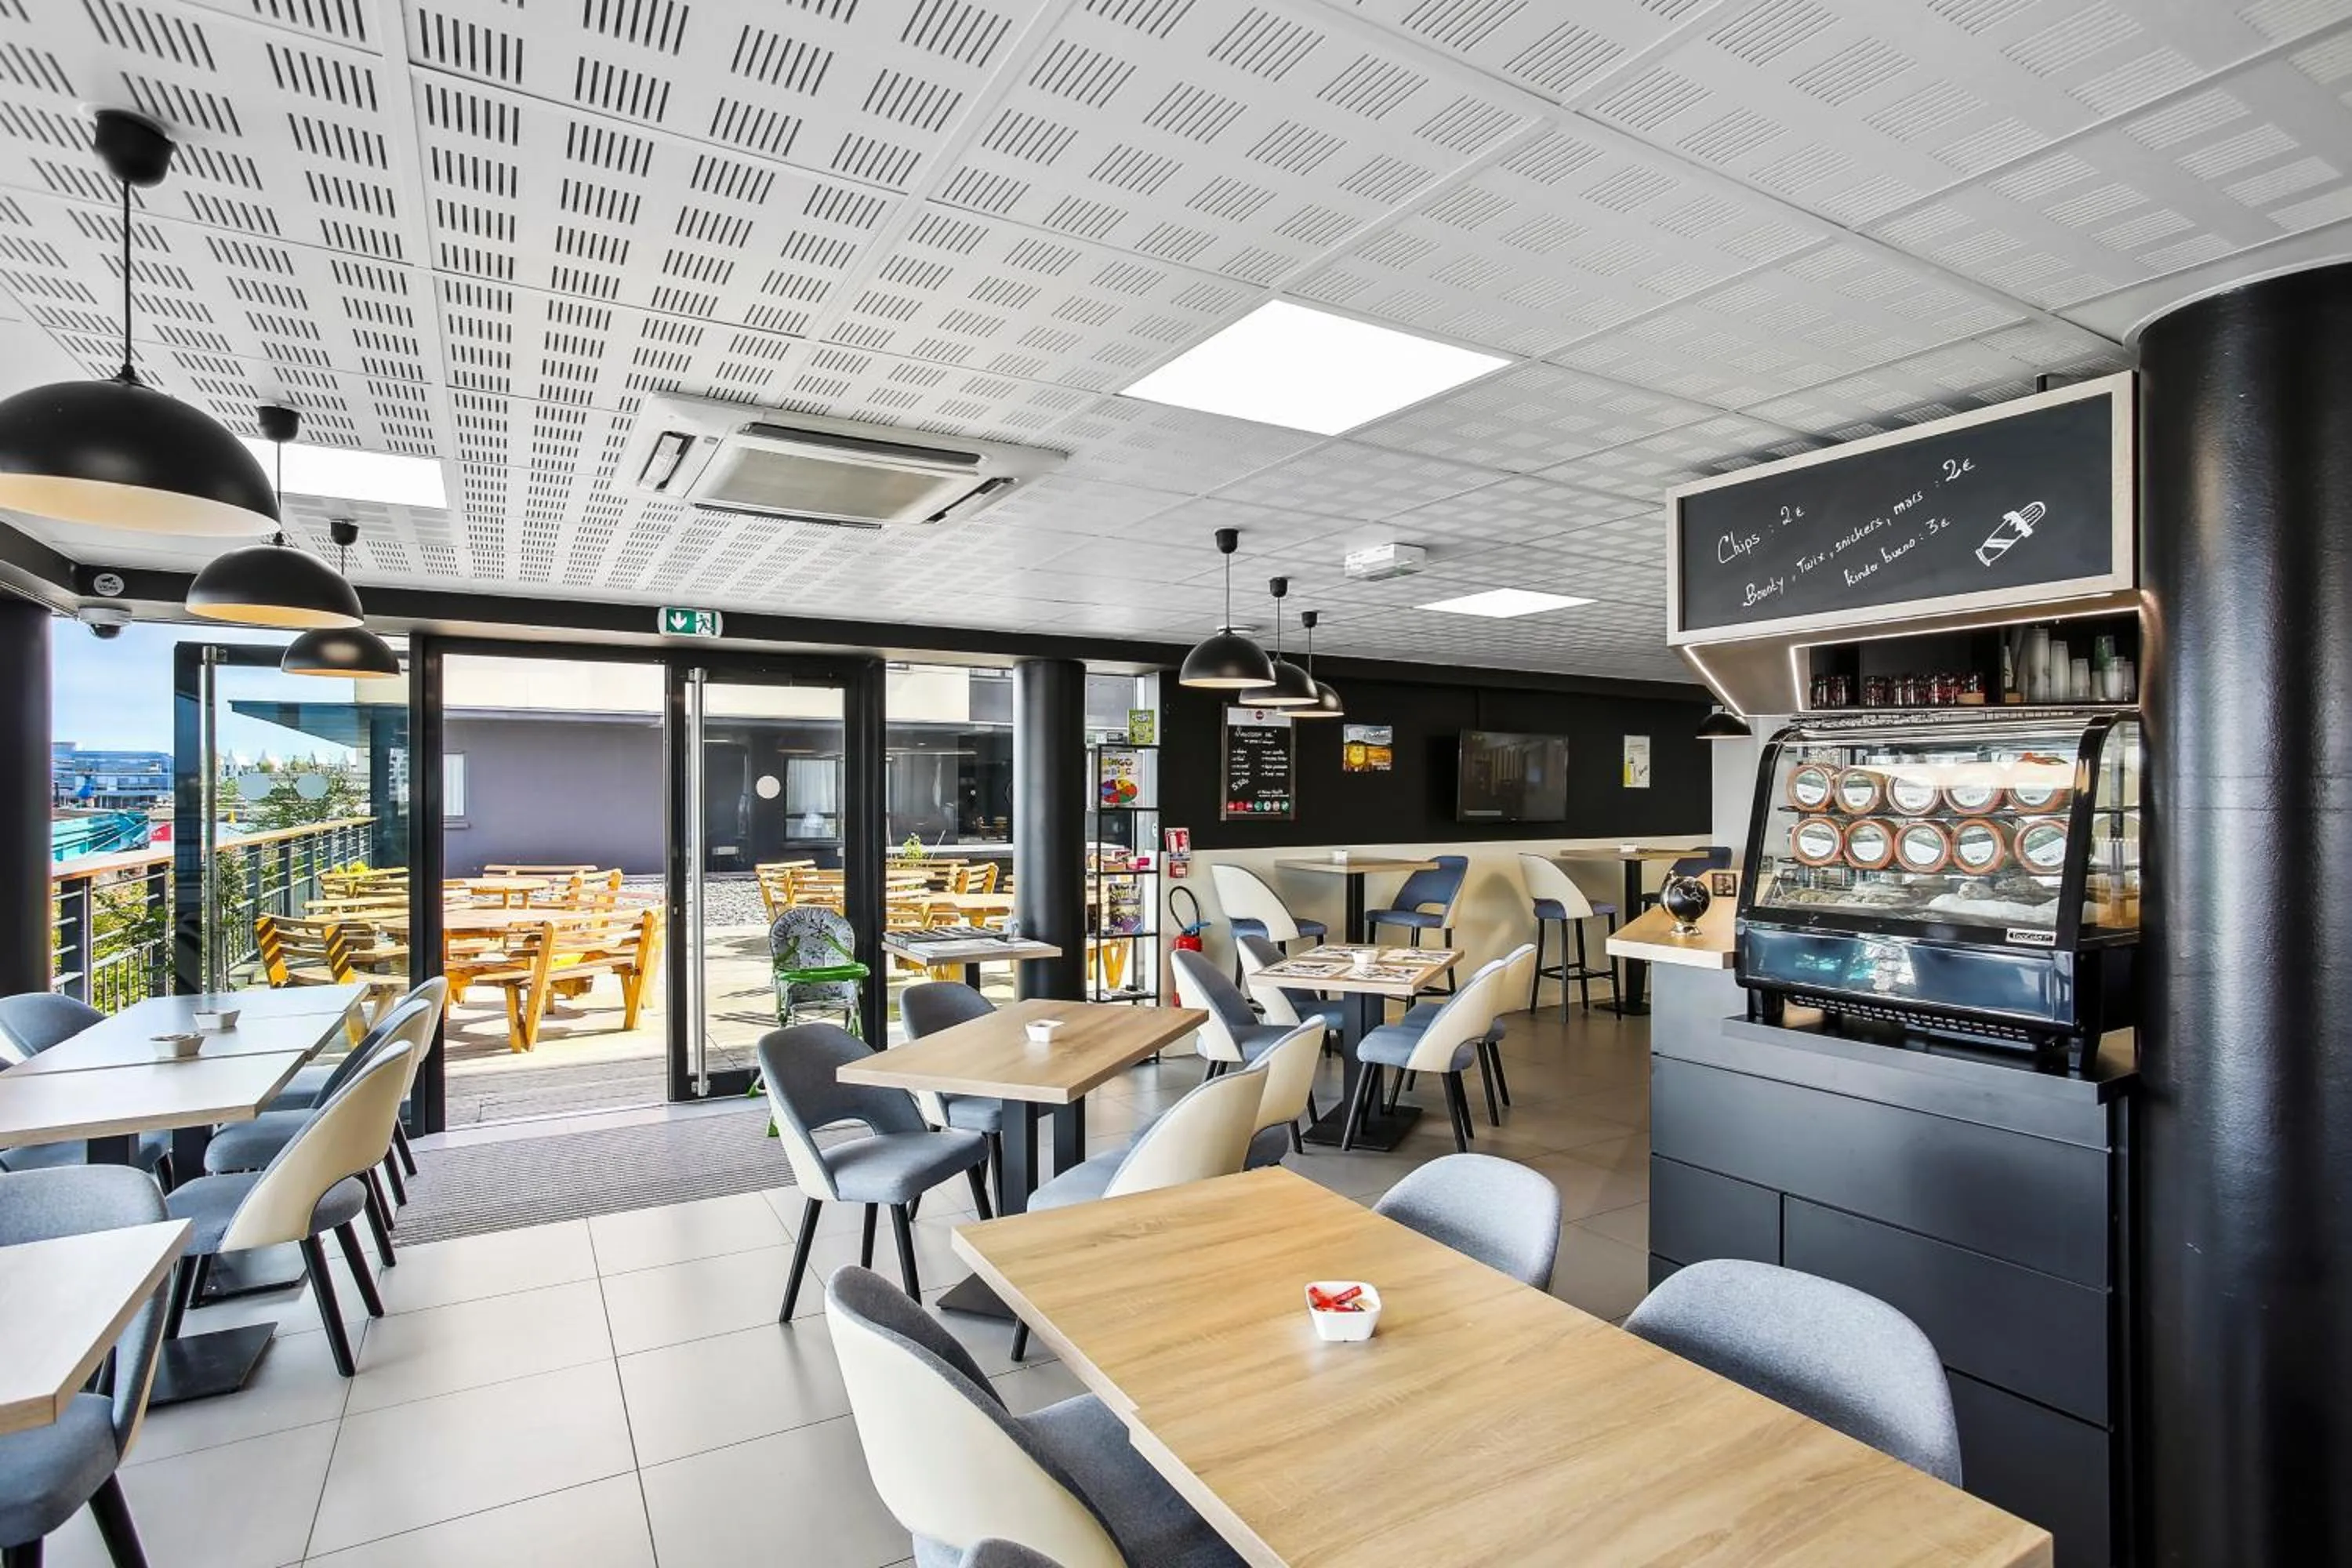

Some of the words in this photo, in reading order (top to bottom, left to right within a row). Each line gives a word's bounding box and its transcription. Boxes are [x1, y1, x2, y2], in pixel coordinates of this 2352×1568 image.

[1893, 490, 1923, 515] mars
[1718, 531, 1760, 564] Chips
[1844, 563, 1878, 586] kinder
